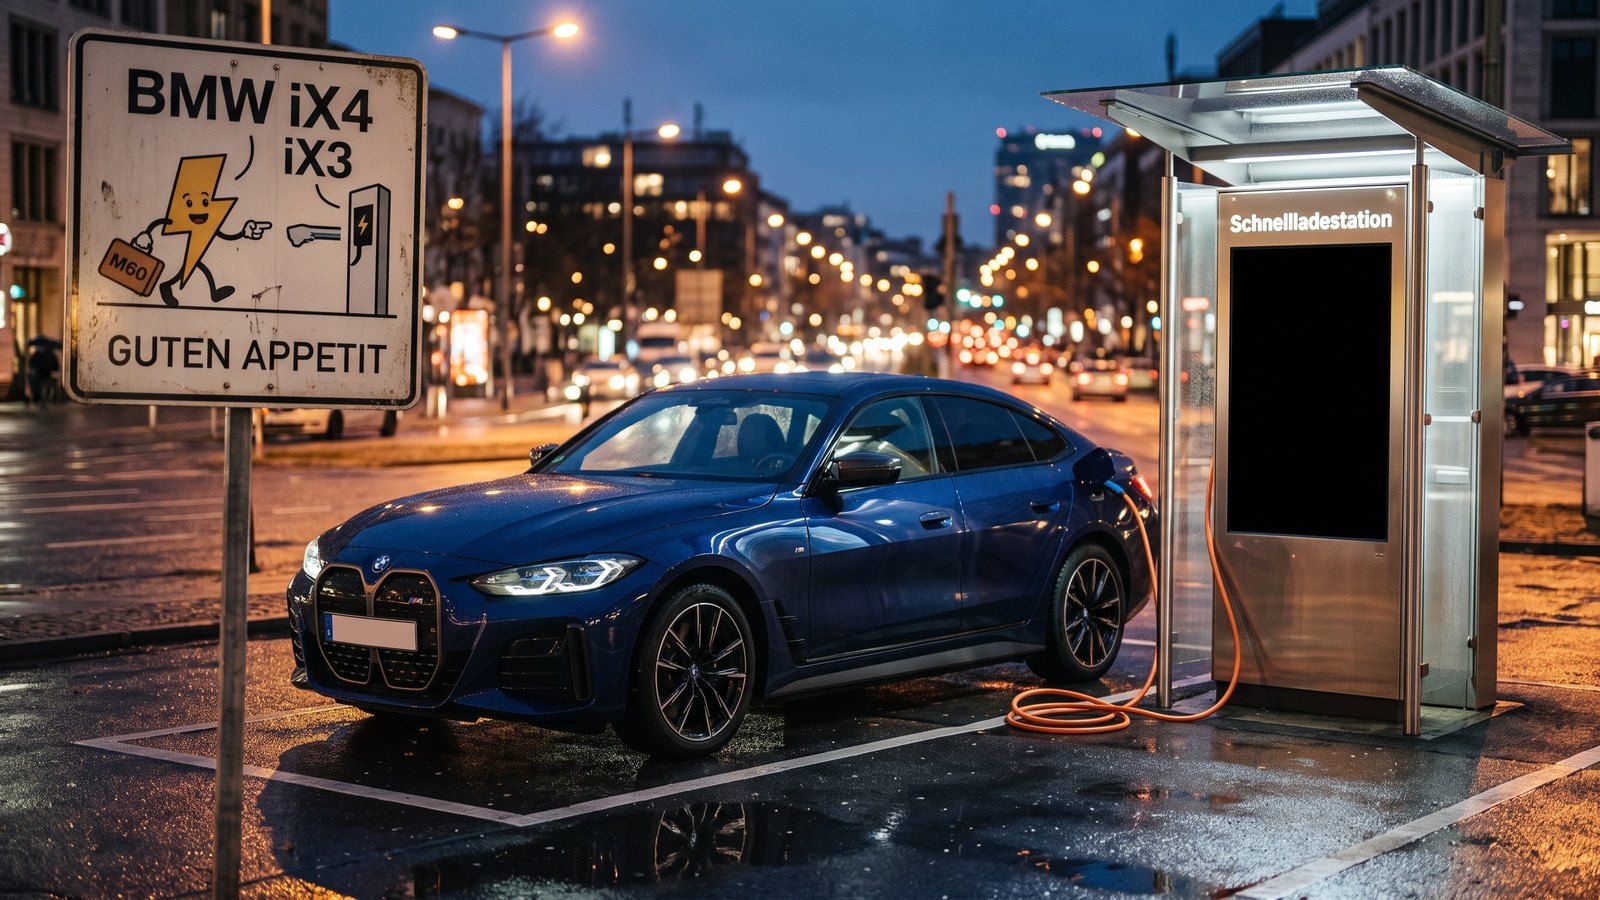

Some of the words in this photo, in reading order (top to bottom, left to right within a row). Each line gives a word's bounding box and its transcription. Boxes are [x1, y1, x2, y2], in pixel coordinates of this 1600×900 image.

[127, 68, 276, 125] BMW
[289, 82, 374, 133] iX4
[284, 136, 353, 180] iX3
[1229, 209, 1393, 234] Schnellladestation
[108, 252, 148, 282] M60
[107, 334, 231, 372] GUTEN
[241, 339, 388, 375] APPETIT
